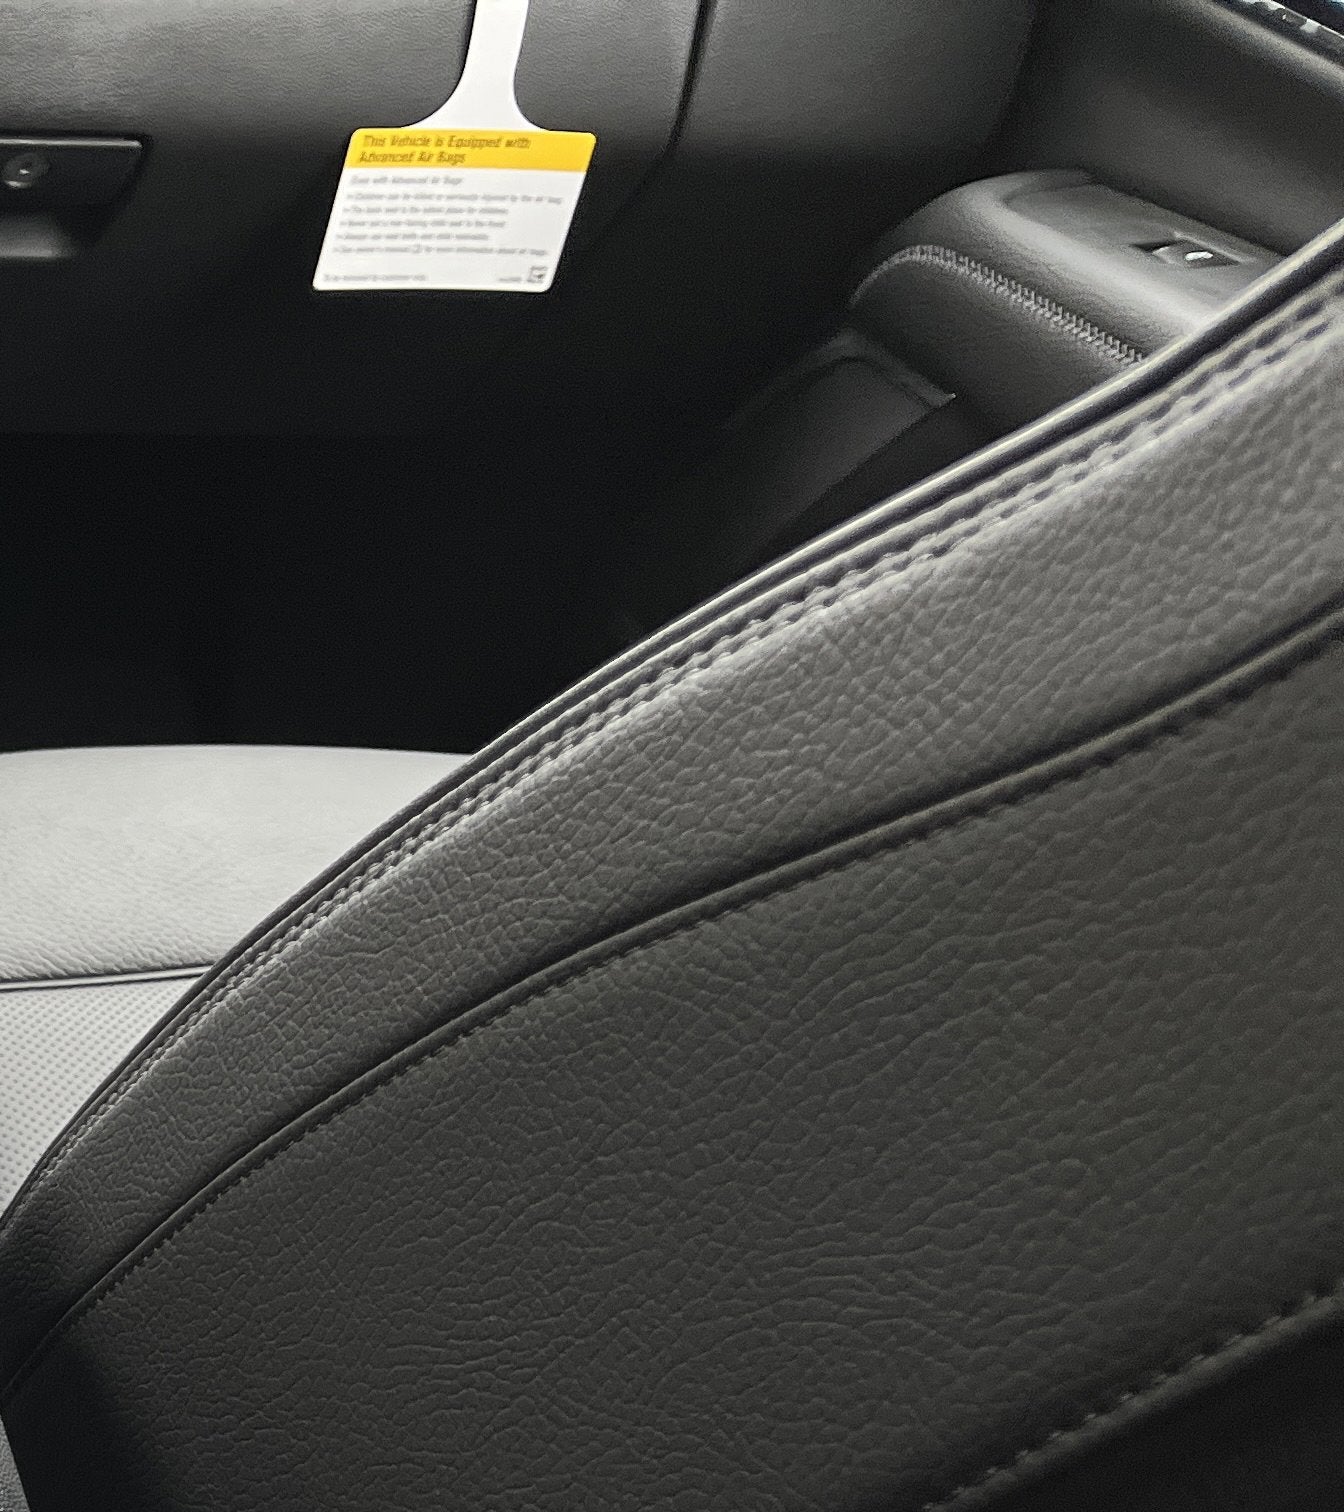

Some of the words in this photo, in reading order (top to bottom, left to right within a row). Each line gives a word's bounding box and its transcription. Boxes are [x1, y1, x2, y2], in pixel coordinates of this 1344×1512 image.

[363, 135, 386, 147] This
[391, 135, 432, 147] Vehicle
[435, 137, 444, 147] is
[447, 135, 502, 149] Equipped
[505, 137, 531, 149] with
[359, 151, 414, 163] Advanced
[416, 152, 434, 163] Air
[437, 152, 467, 165] Bags
